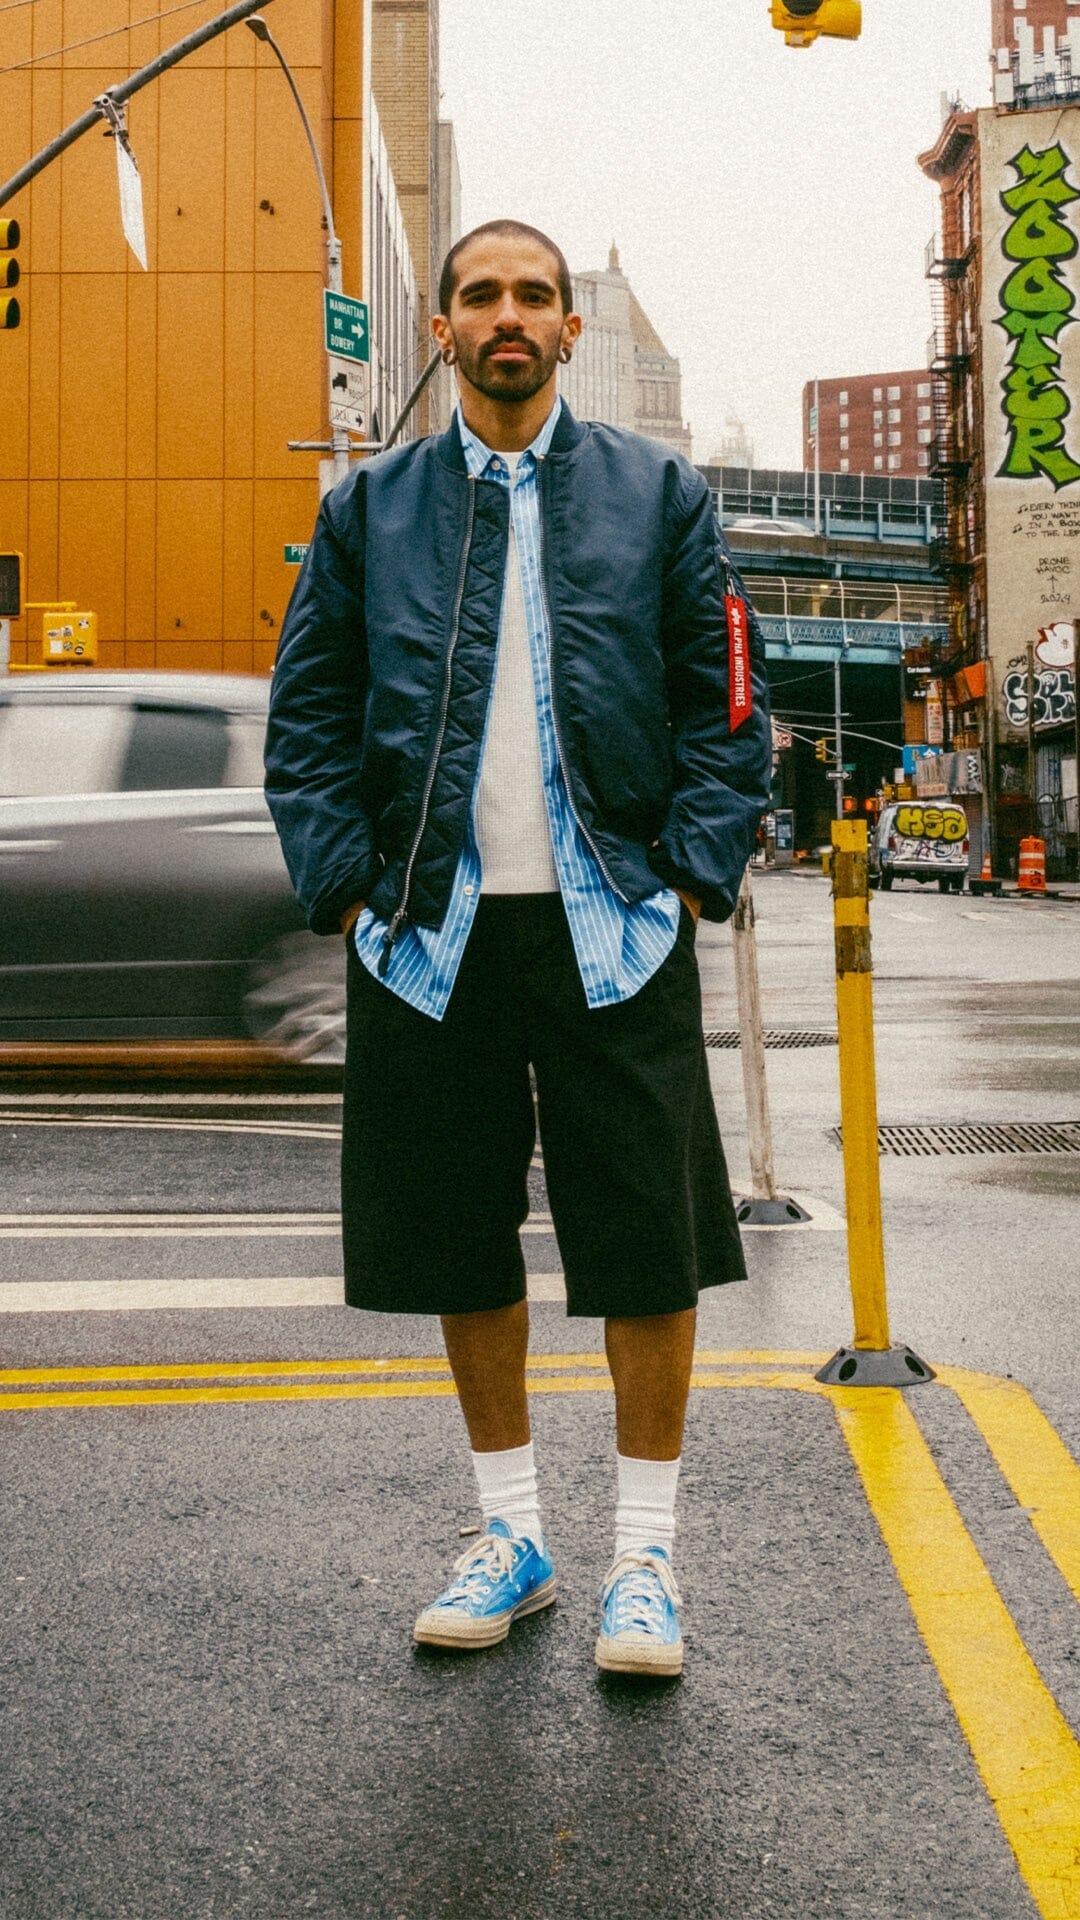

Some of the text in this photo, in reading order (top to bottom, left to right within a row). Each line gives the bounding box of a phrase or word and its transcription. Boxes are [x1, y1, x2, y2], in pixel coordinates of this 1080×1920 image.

[330, 299, 365, 320] MANHATTAN
[333, 317, 344, 331] BR
[331, 335, 355, 351] BOWERY
[348, 371, 362, 384] TRUCK
[1058, 501, 1080, 509] THIN
[1051, 511, 1079, 519] WANT
[1029, 521, 1041, 529] IN
[1040, 529, 1060, 537] THE
[1063, 529, 1080, 537] LEF
[291, 546, 308, 556] PIK
[733, 627, 746, 707] ALPHA INDUSTRIES
